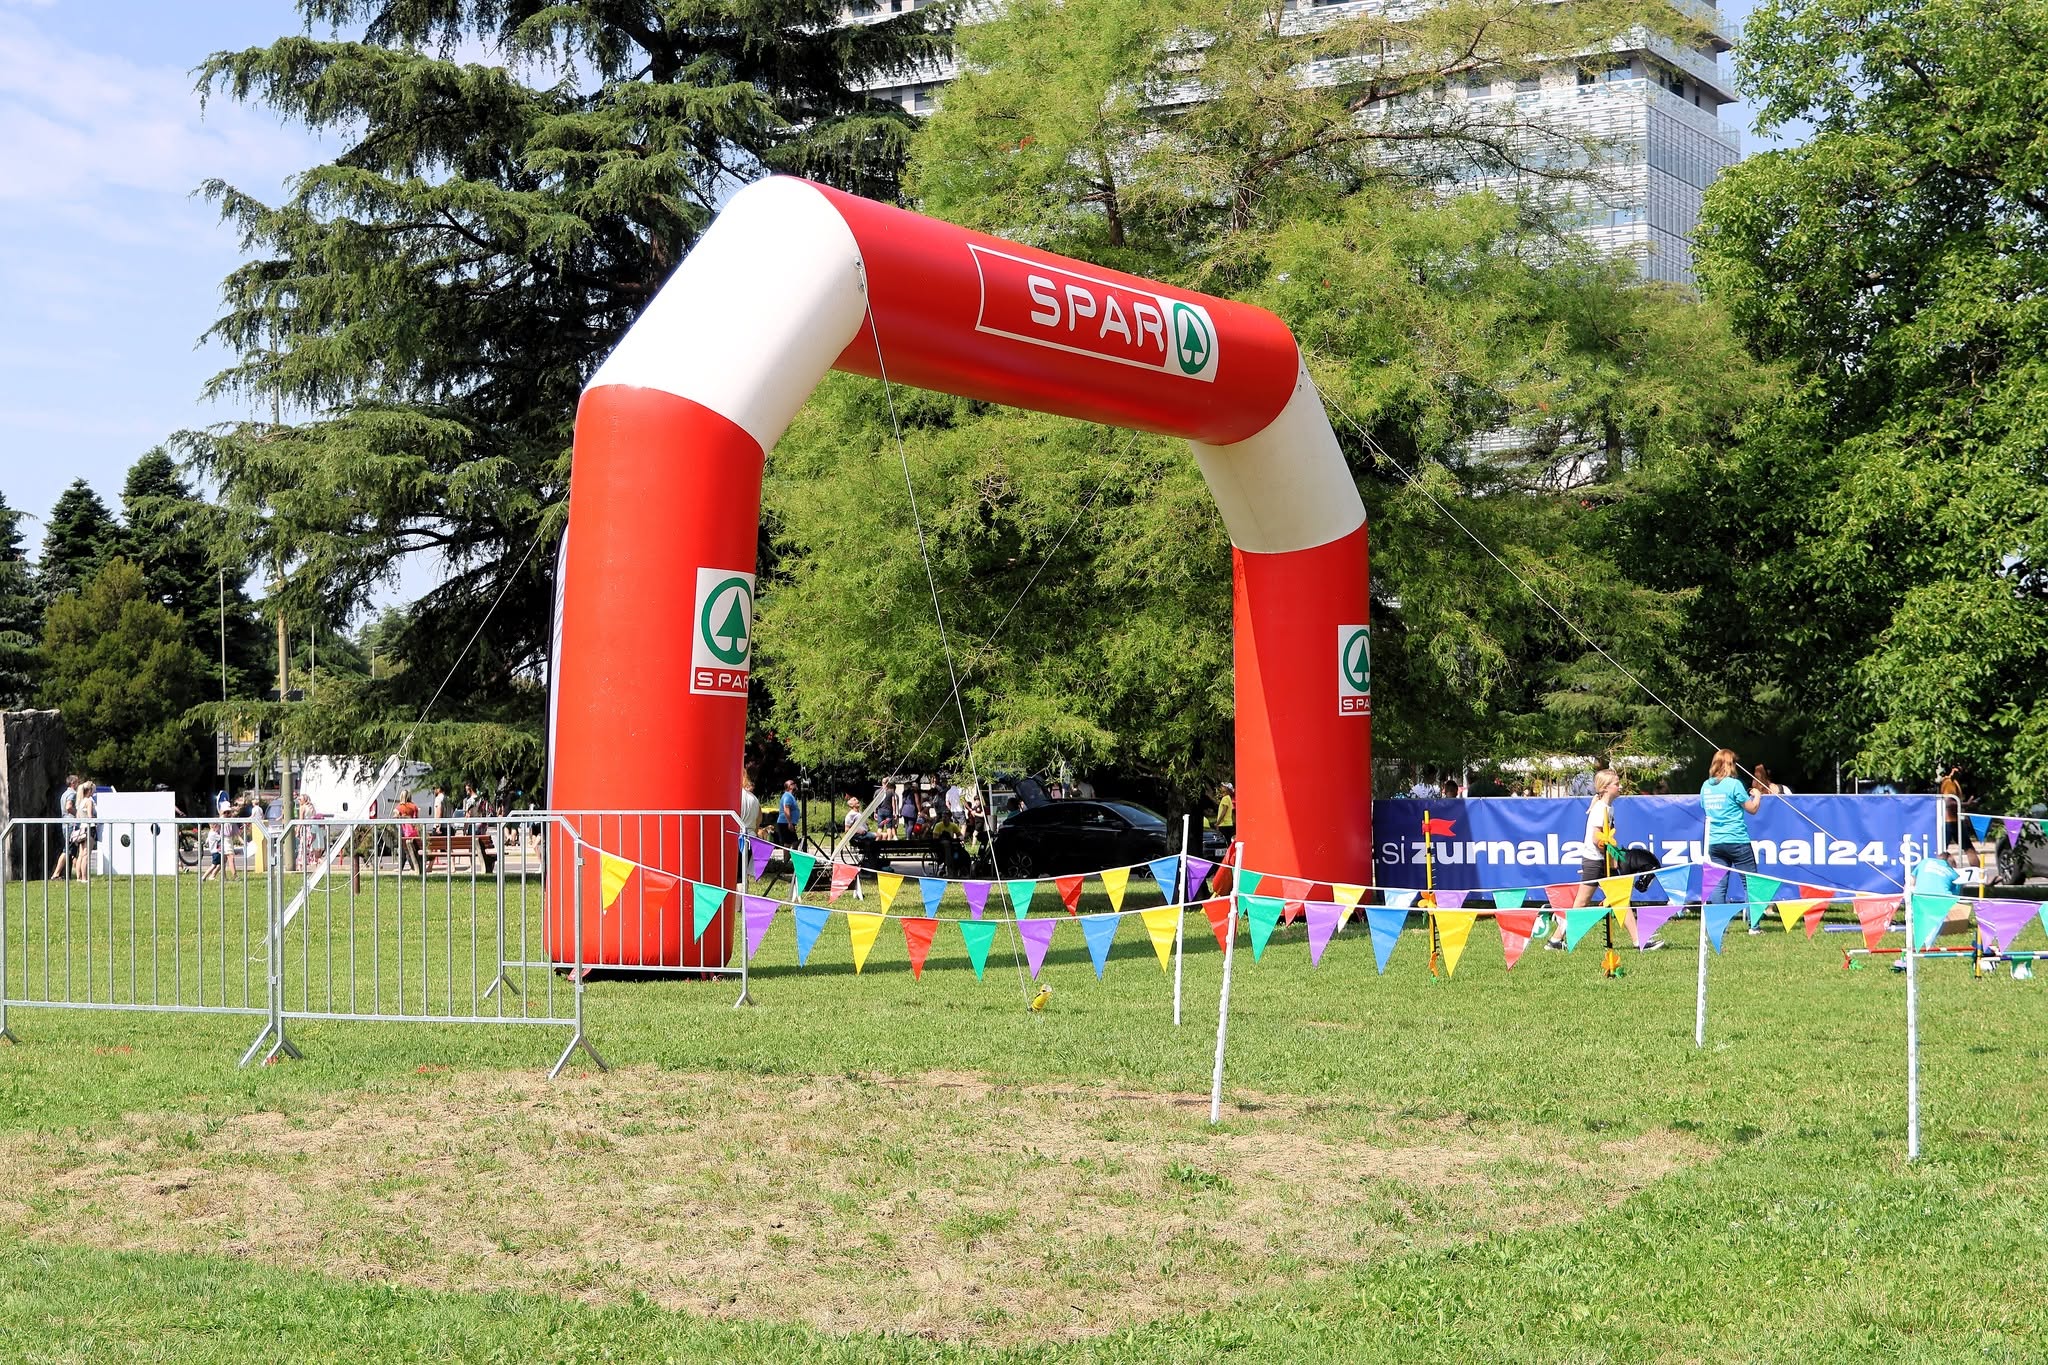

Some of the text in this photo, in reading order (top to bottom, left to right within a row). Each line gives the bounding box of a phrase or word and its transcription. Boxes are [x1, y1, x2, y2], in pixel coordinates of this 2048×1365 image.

[1027, 274, 1164, 352] SPAR
[1661, 833, 1929, 866] zunal24.si
[1965, 869, 1974, 881] 7
